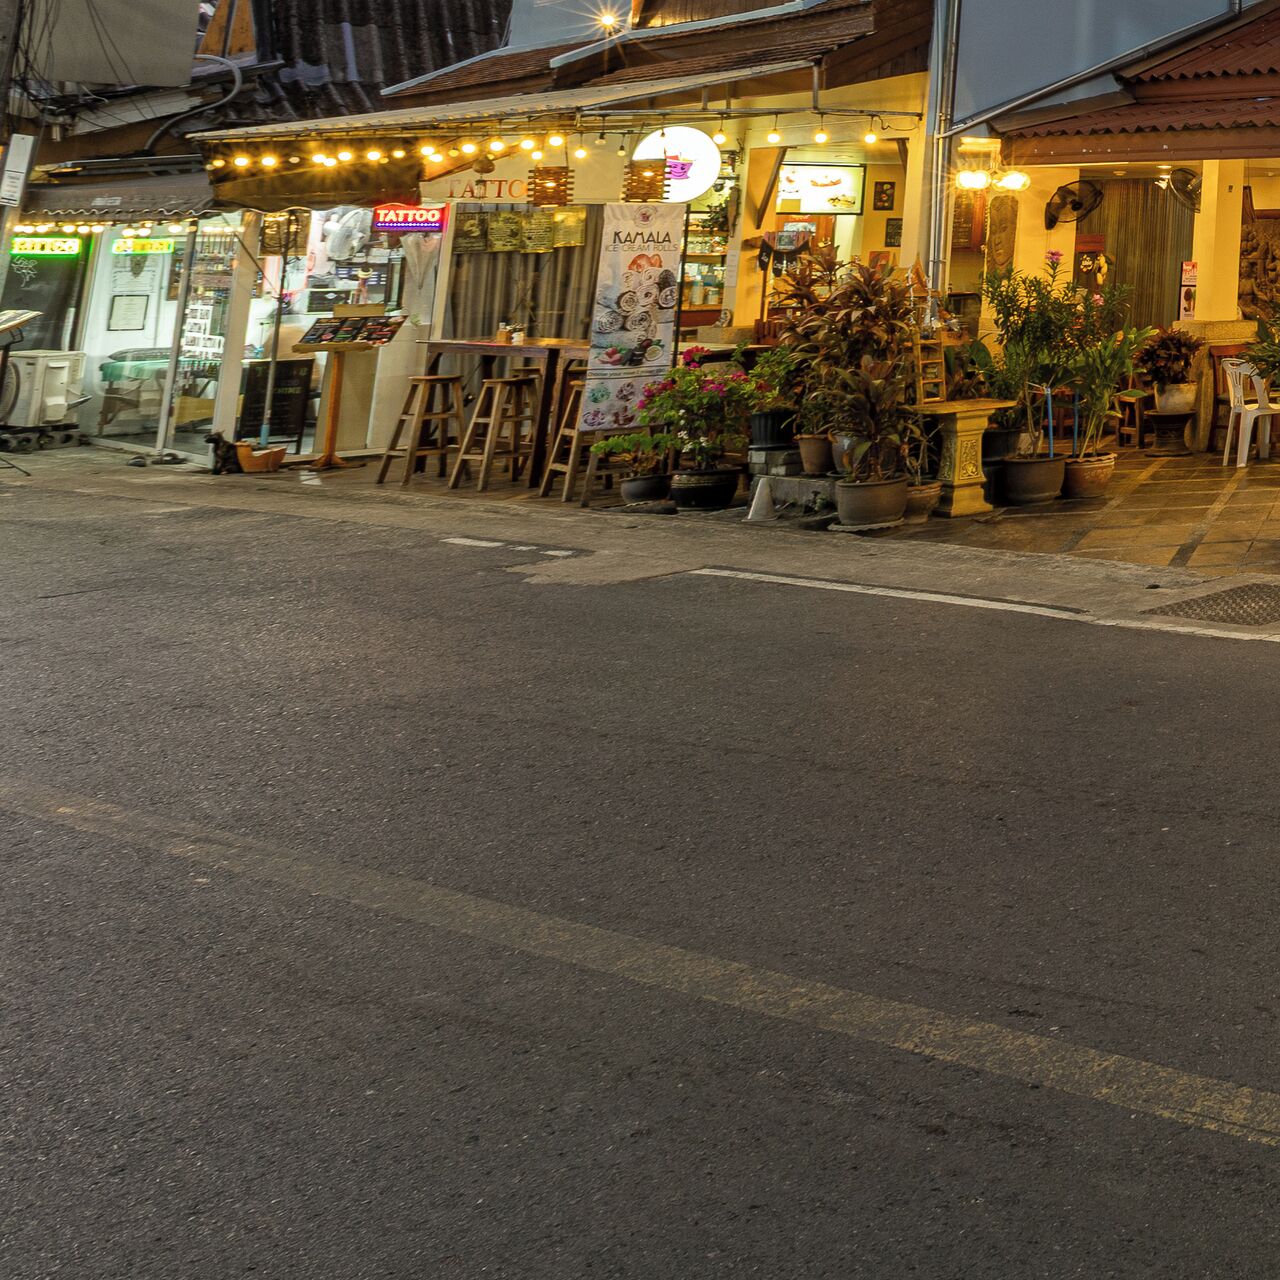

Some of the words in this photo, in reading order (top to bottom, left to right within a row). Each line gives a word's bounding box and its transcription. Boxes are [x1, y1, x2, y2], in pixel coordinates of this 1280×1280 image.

[377, 209, 441, 222] TATTOO
[613, 231, 671, 244] KAMALA
[605, 244, 619, 252] ICE
